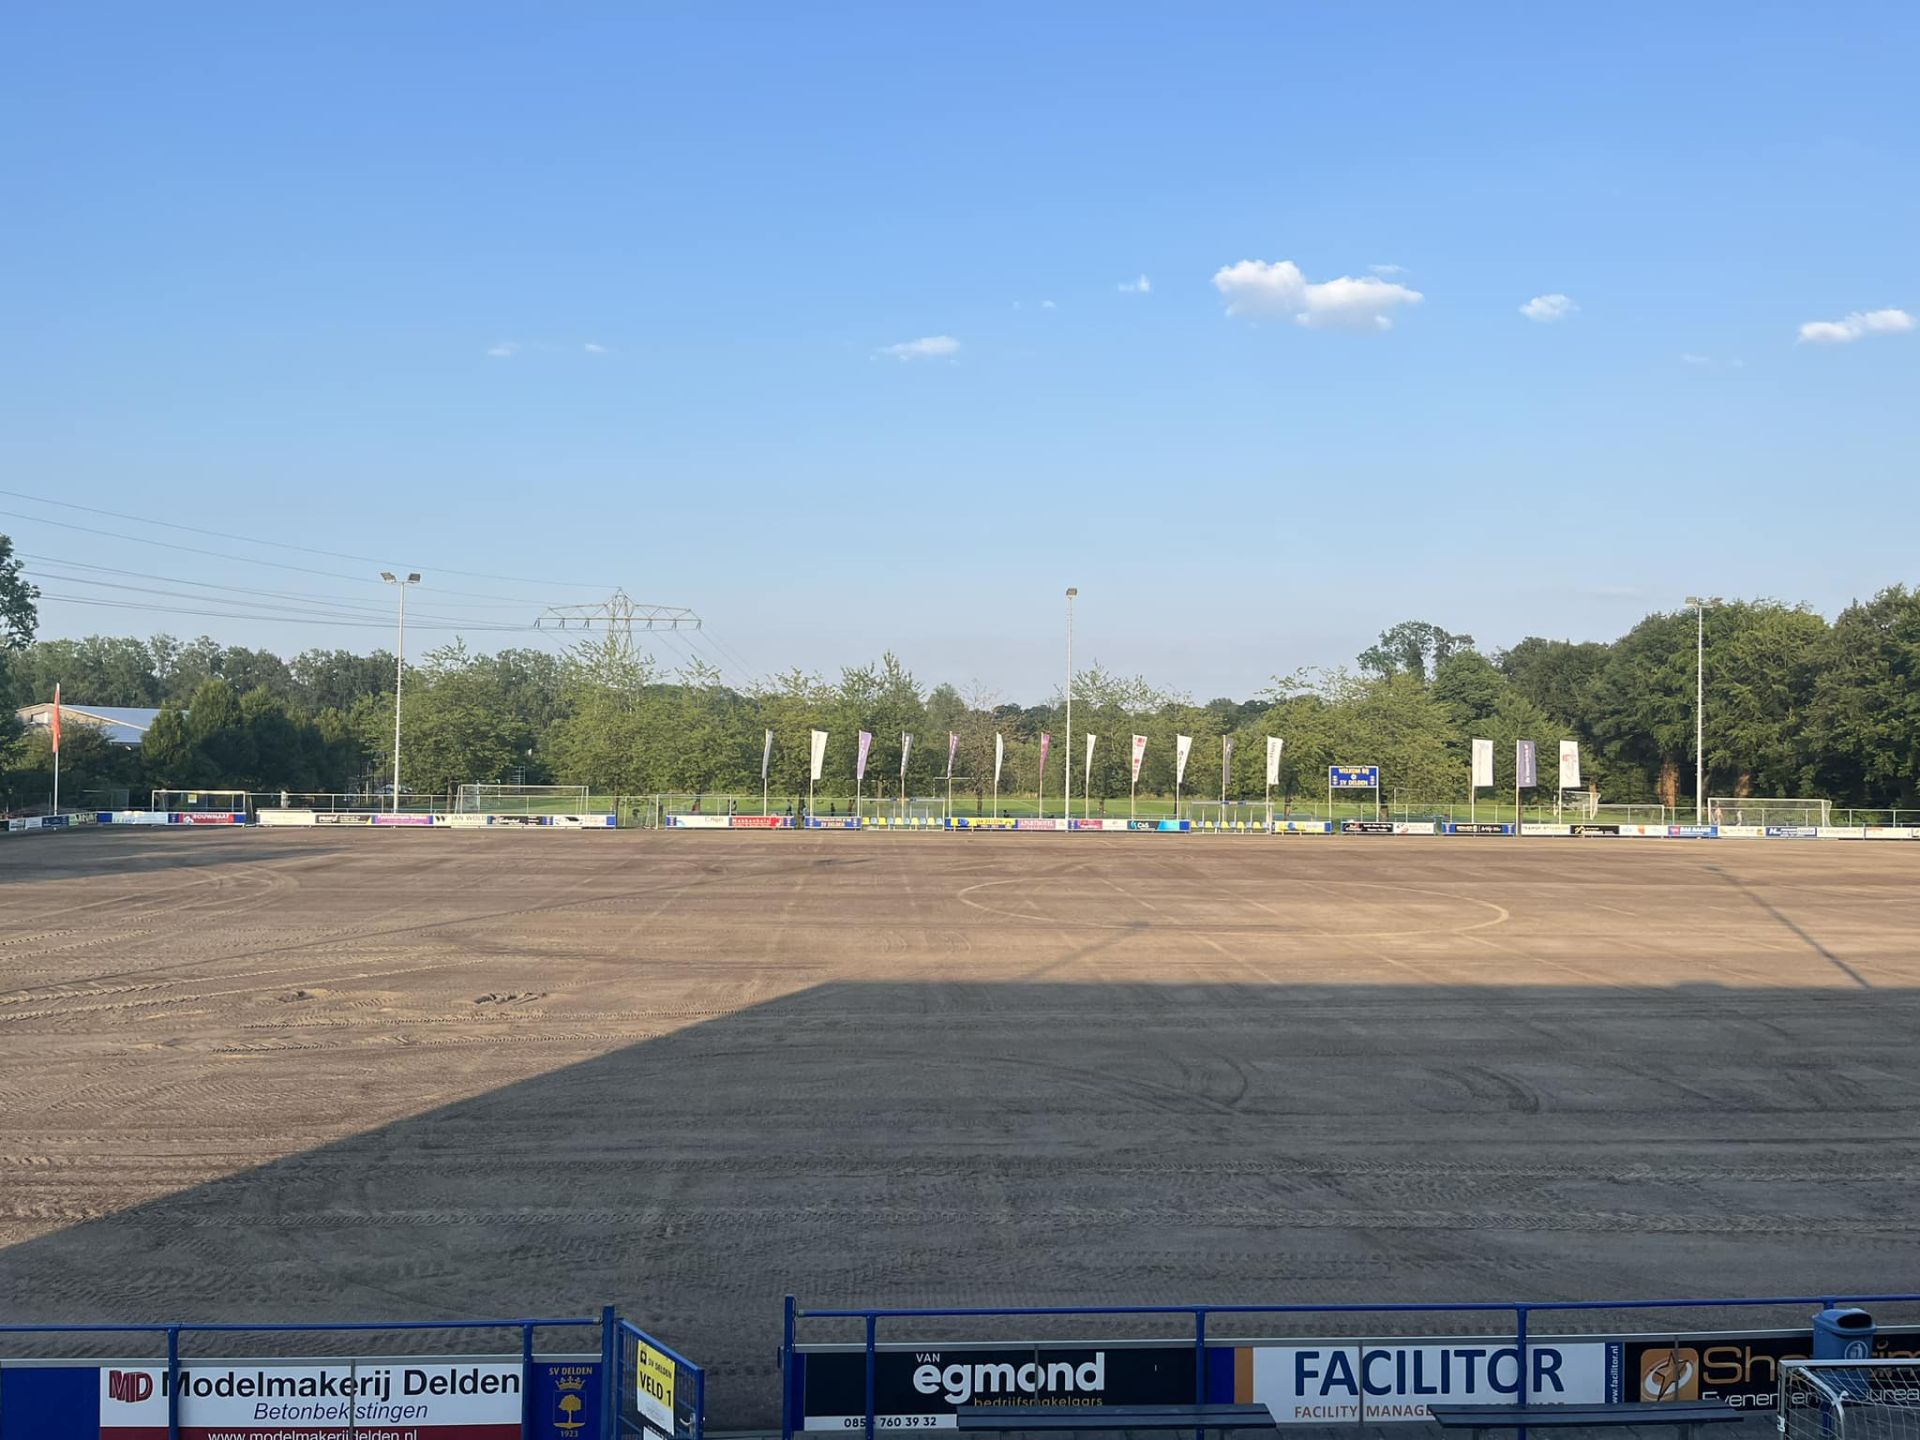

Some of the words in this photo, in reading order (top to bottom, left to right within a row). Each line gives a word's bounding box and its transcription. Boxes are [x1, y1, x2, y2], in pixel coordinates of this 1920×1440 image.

[916, 1353, 940, 1363] VAN
[549, 1367, 560, 1375] SV
[562, 1367, 593, 1375] DELDEN
[913, 1352, 1105, 1404] egmond
[1294, 1348, 1565, 1396] FACILITOR
[108, 1370, 153, 1403] MD
[162, 1370, 391, 1402] Modelmakerij
[404, 1368, 520, 1395] Delden
[640, 1371, 663, 1400] VELD
[666, 1390, 672, 1407] 1
[254, 1402, 428, 1423] Betonbekstingen
[844, 1418, 867, 1428] 085
[880, 1417, 902, 1427] 760
[905, 1416, 920, 1427] 39
[923, 1416, 937, 1426] 32
[1294, 1405, 1358, 1419] FACILITY
[208, 1429, 418, 1440] wwwmodelmakerijdeldennl
